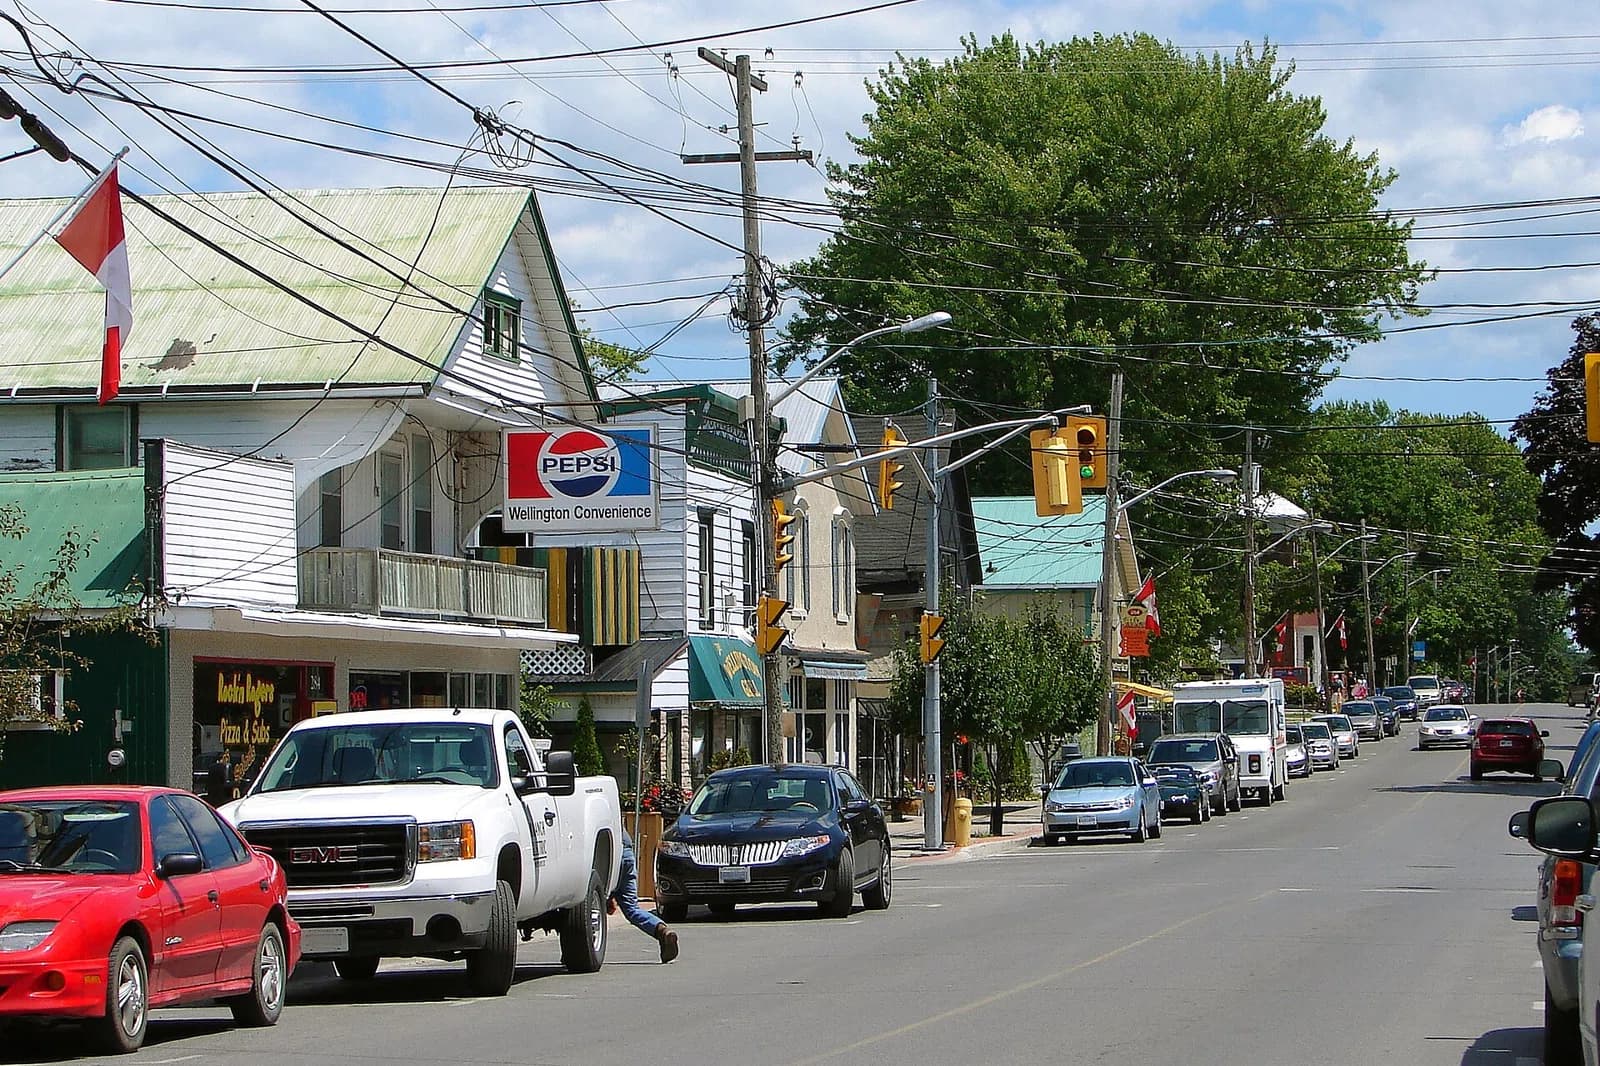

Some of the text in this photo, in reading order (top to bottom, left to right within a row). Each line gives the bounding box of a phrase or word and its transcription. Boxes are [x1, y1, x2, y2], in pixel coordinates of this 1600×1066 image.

[542, 456, 616, 474] PEPSI
[508, 504, 651, 523] Wellington Convenience
[245, 673, 275, 718] Rogers
[220, 717, 270, 745] Pizza & Subs
[289, 845, 358, 864] GMC
